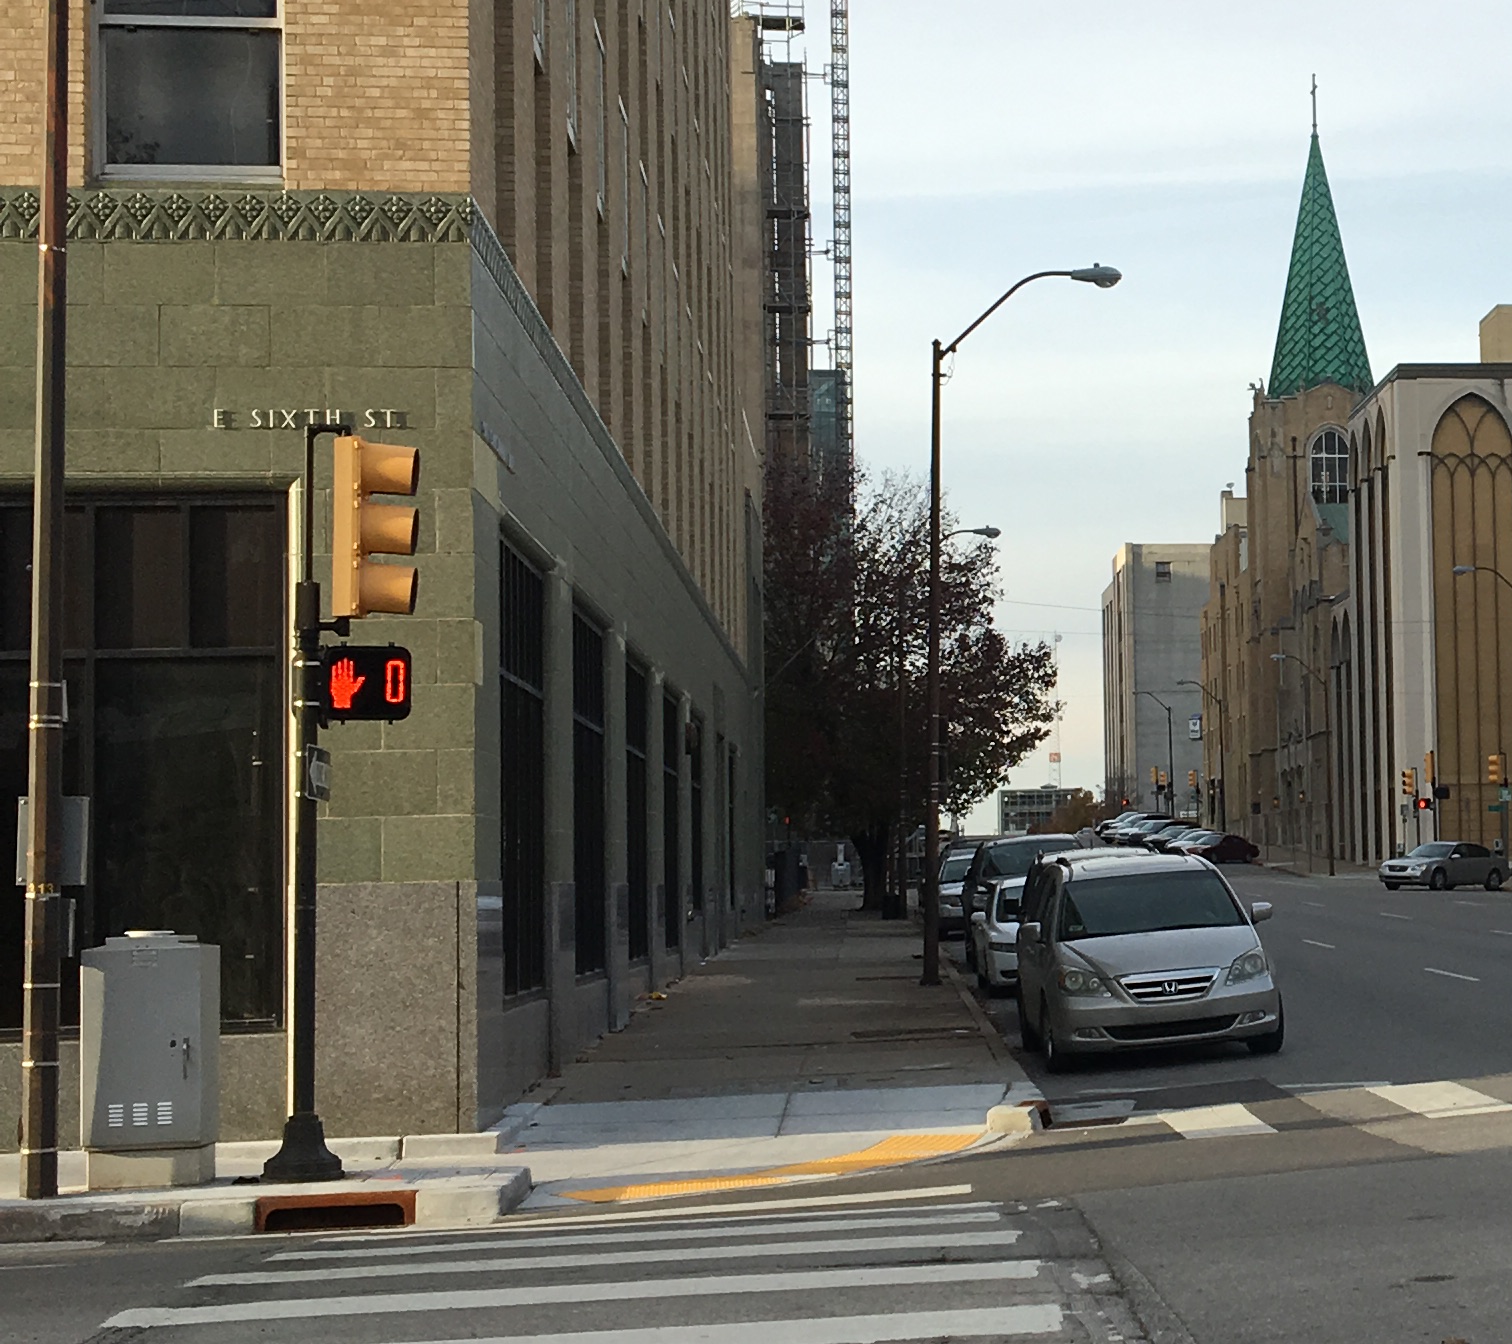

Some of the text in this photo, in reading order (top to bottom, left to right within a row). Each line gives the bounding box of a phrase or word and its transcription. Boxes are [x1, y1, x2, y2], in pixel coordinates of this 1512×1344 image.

[213, 408, 226, 428] E
[249, 408, 341, 428] SIXTH
[385, 659, 405, 704] 0
